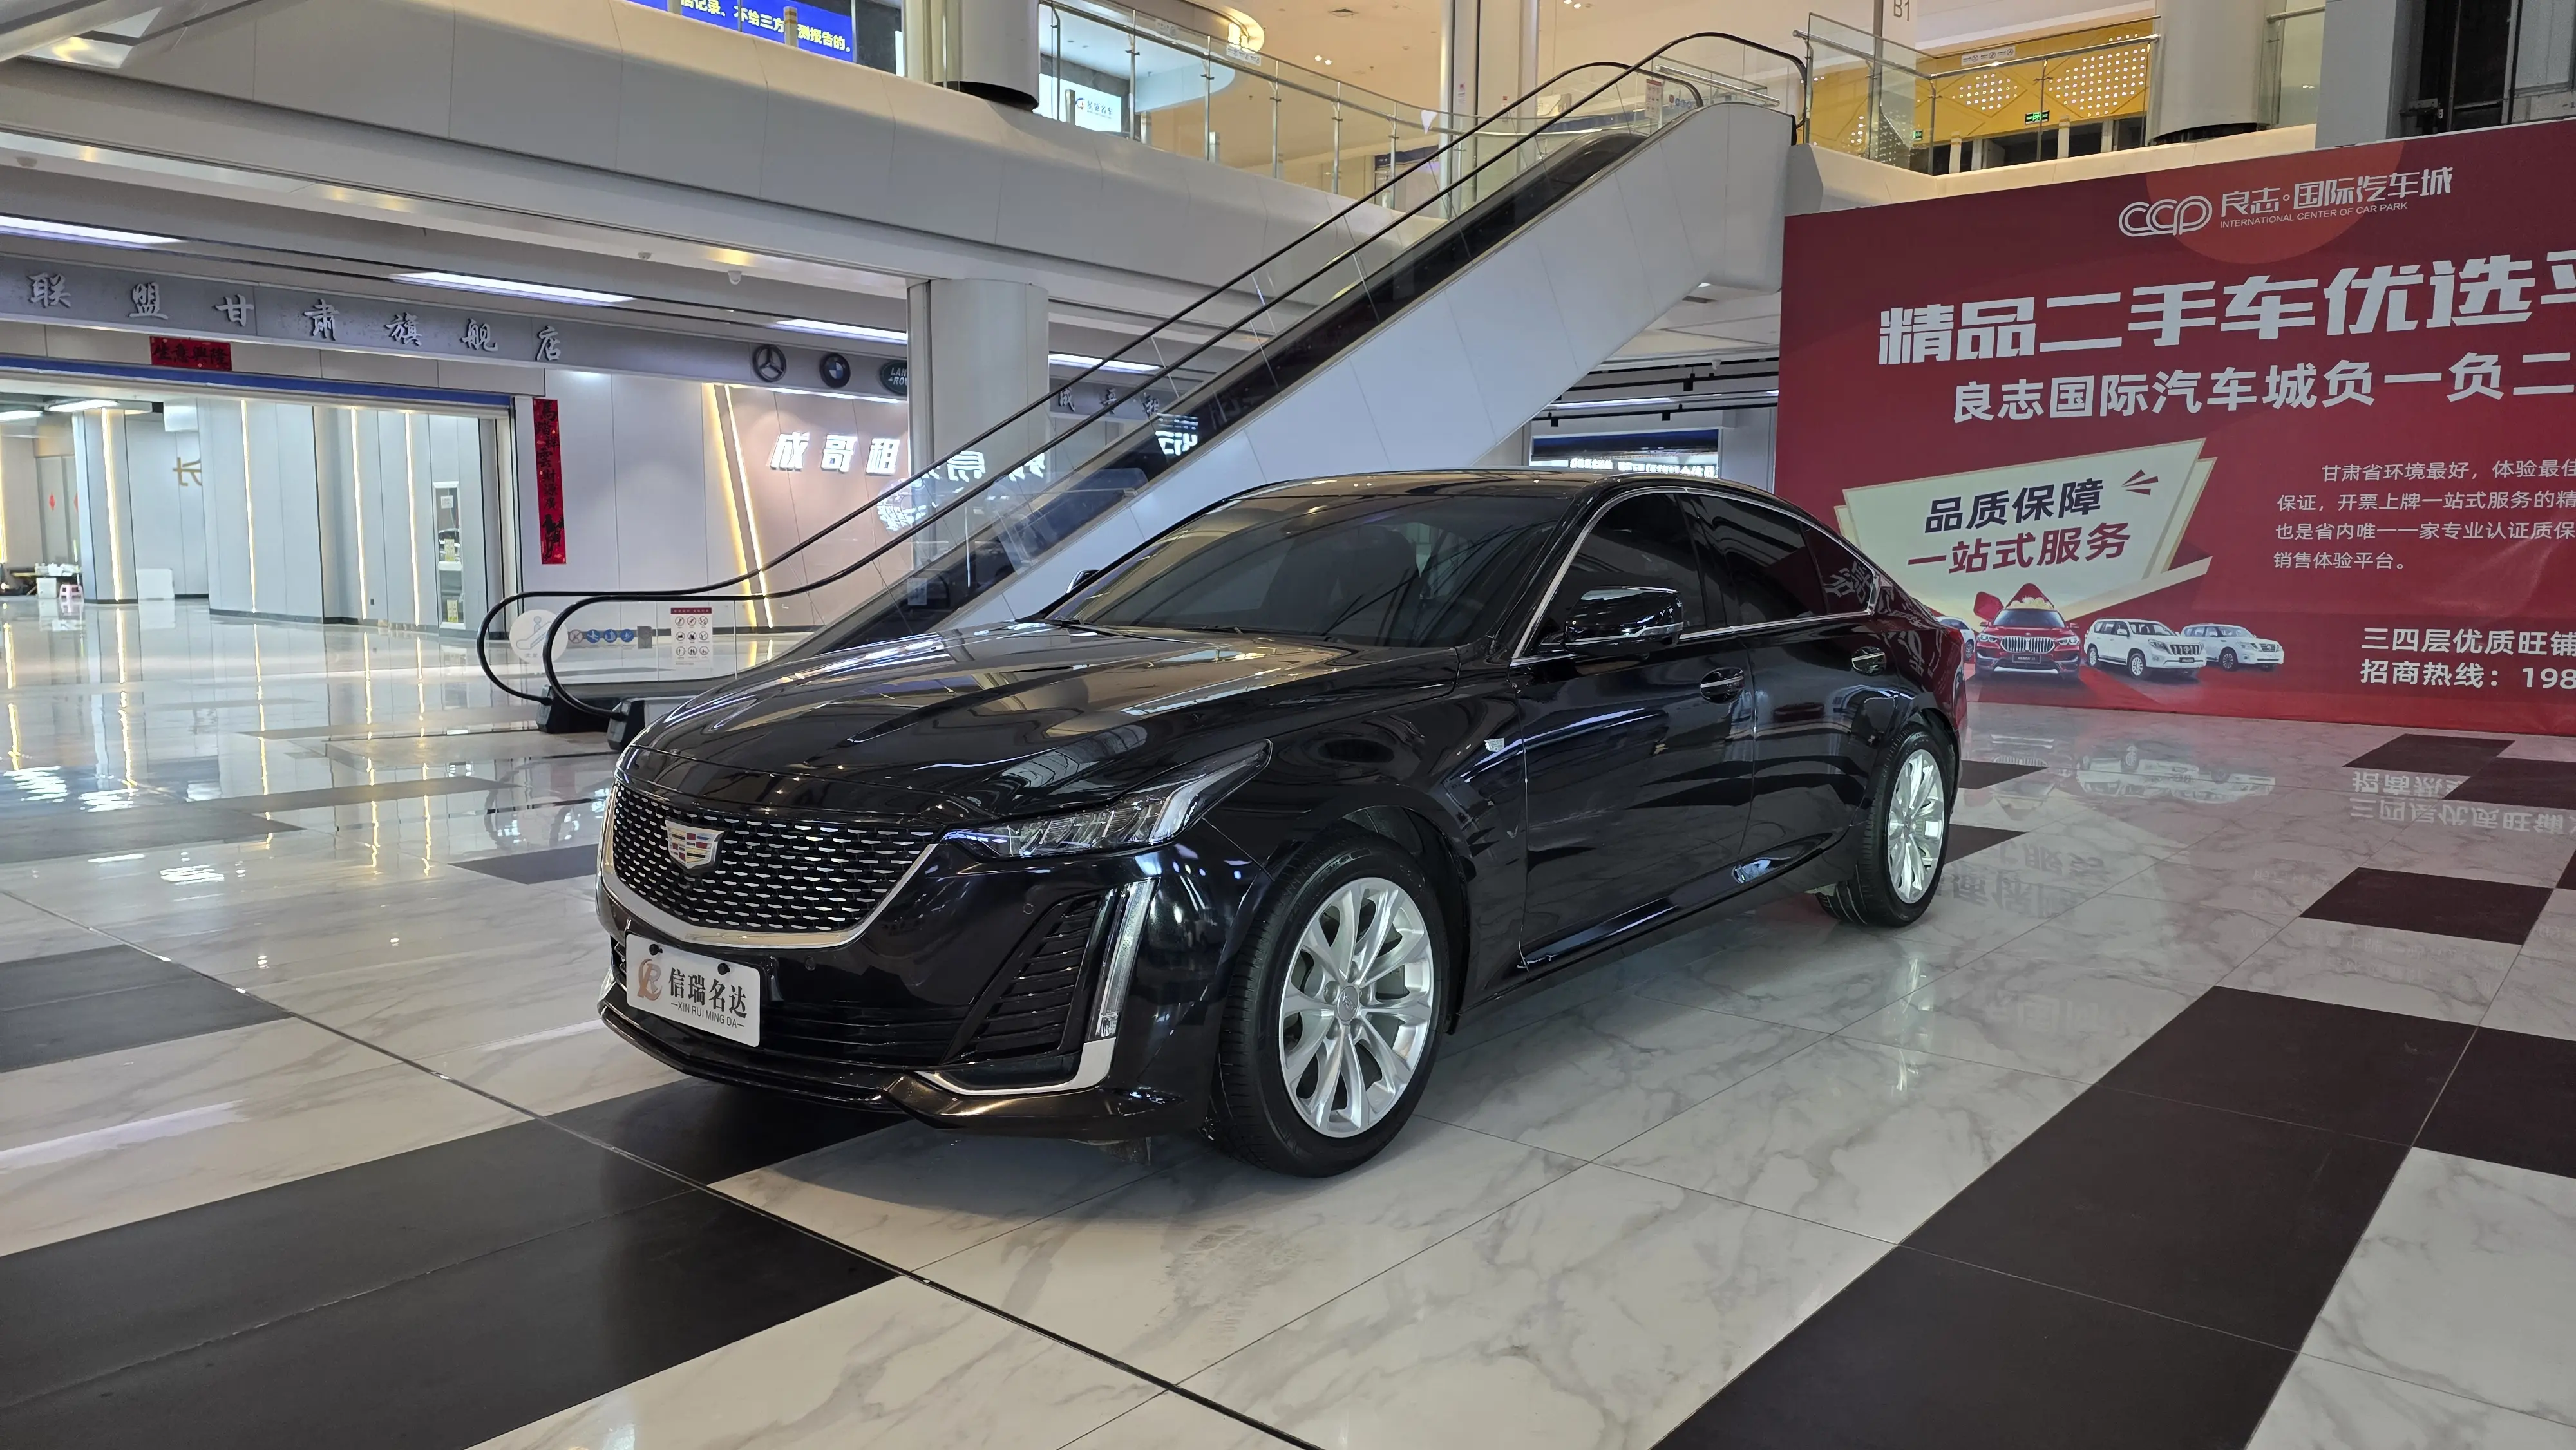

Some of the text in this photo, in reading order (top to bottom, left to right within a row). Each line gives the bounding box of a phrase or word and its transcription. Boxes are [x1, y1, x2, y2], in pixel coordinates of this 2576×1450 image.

[681, 0, 851, 52] 记录、不给三方测报告的。
[2220, 202, 2408, 229] INTERNATIONAL CENTER OF CAR PARK
[28, 272, 562, 362] 联盟甘肃旗舰店
[891, 366, 907, 376] LAN
[1924, 478, 2104, 534] 品质保障
[1908, 522, 2132, 576] 一站式服务
[2273, 551, 2404, 570] 销售体验平台。
[2361, 627, 2576, 657] 三四层优质旺铺
[668, 966, 748, 1019] 信瑞名达
[691, 1005, 704, 1017] RUI
[706, 1009, 724, 1024] MING
